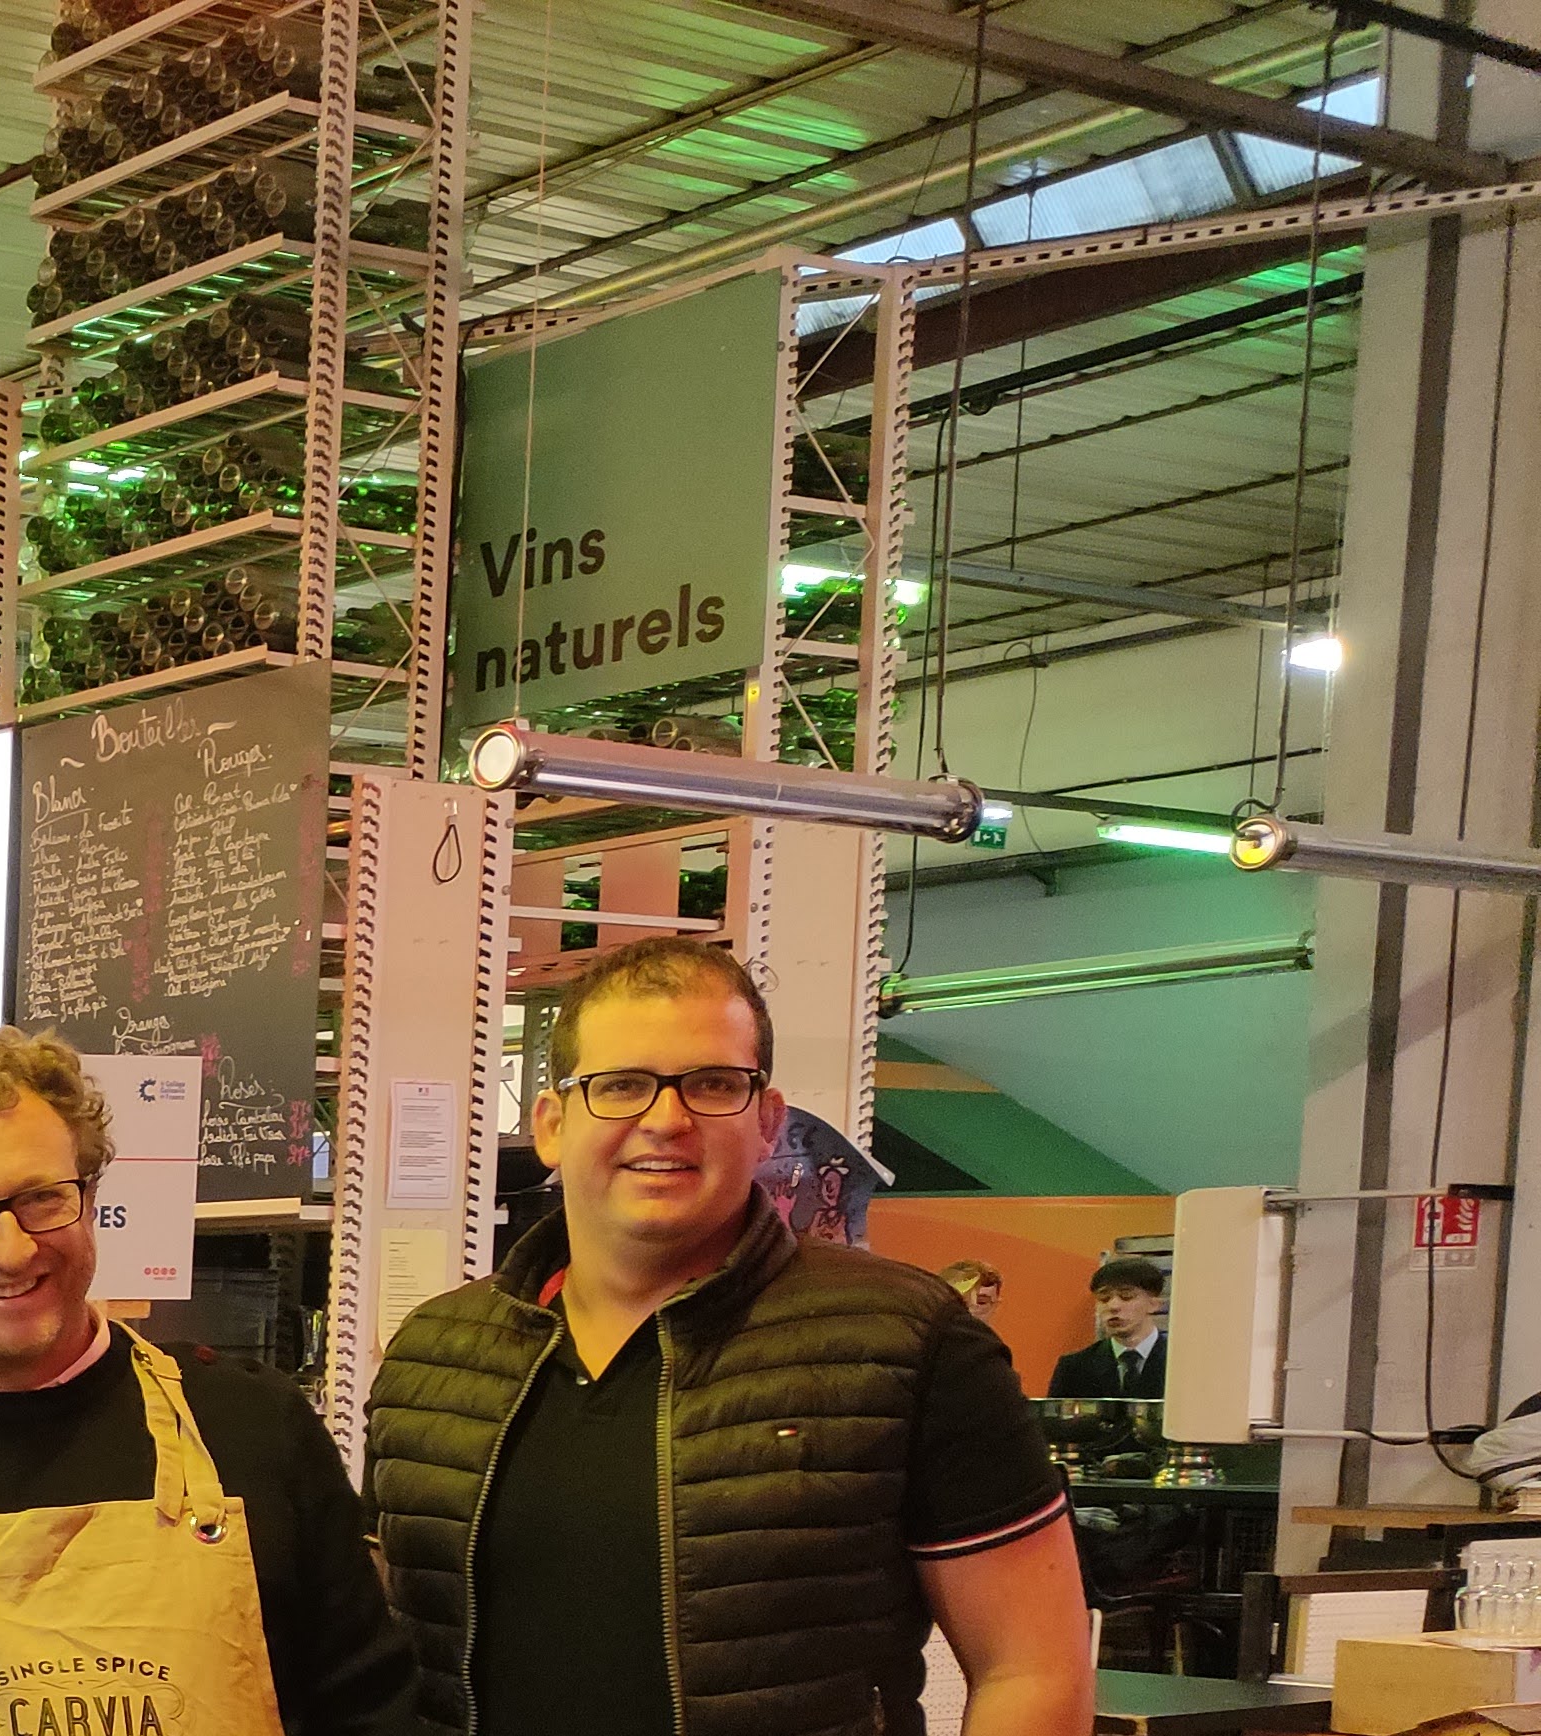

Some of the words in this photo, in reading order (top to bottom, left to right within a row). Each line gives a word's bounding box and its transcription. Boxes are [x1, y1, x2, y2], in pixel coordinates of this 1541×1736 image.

[480, 526, 606, 598] Vins
[476, 584, 726, 692] naturels
[93, 1205, 127, 1228] ES
[95, 1657, 171, 1682] SPICE
